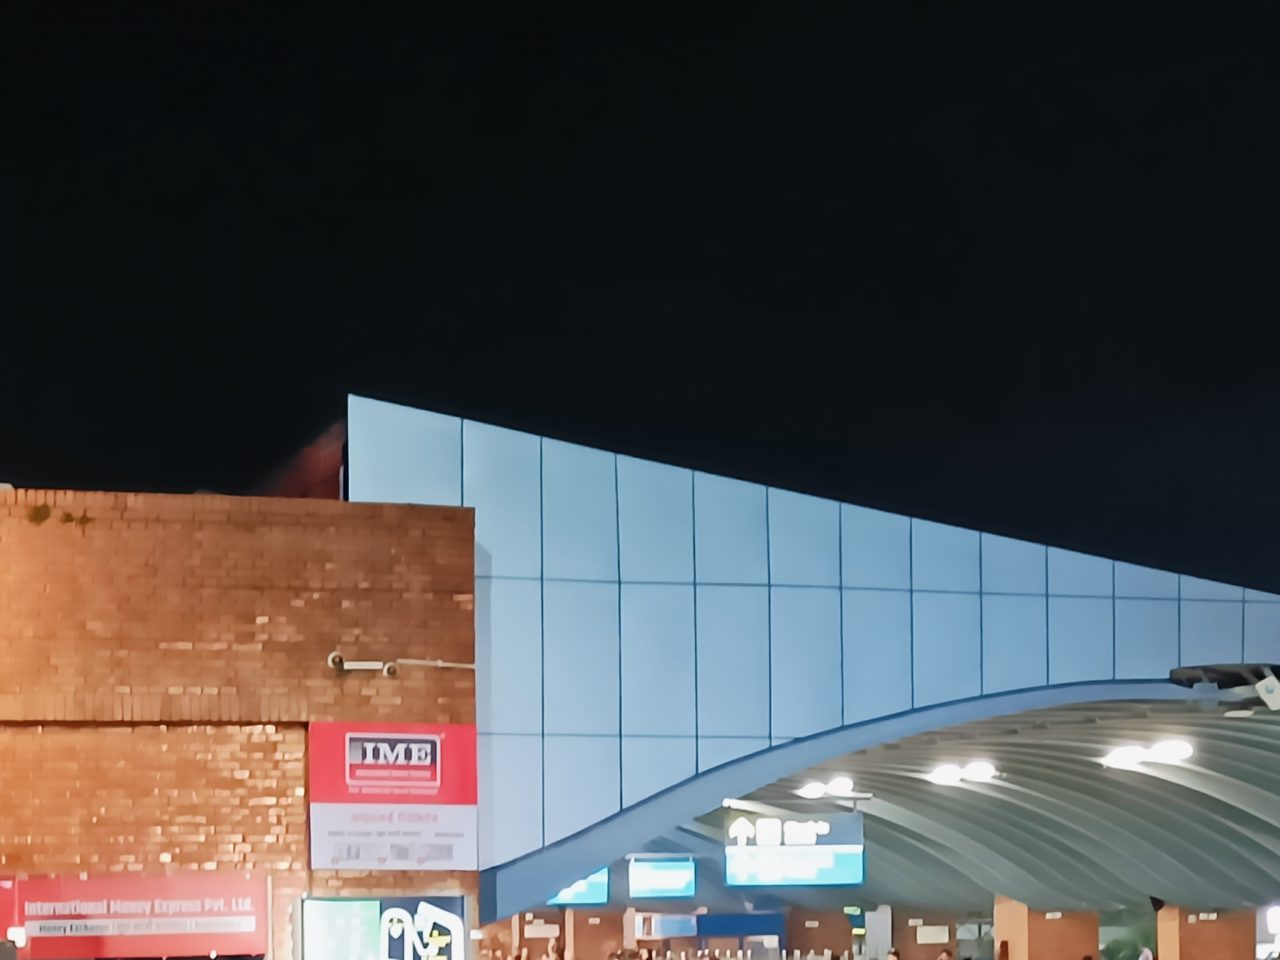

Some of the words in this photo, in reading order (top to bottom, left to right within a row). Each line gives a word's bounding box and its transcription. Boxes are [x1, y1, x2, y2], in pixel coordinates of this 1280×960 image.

[363, 742, 432, 766] IME
[25, 900, 107, 915] International
[154, 898, 201, 915] Express
[204, 897, 228, 912] Pvt.
[231, 896, 255, 912] Ltd.
